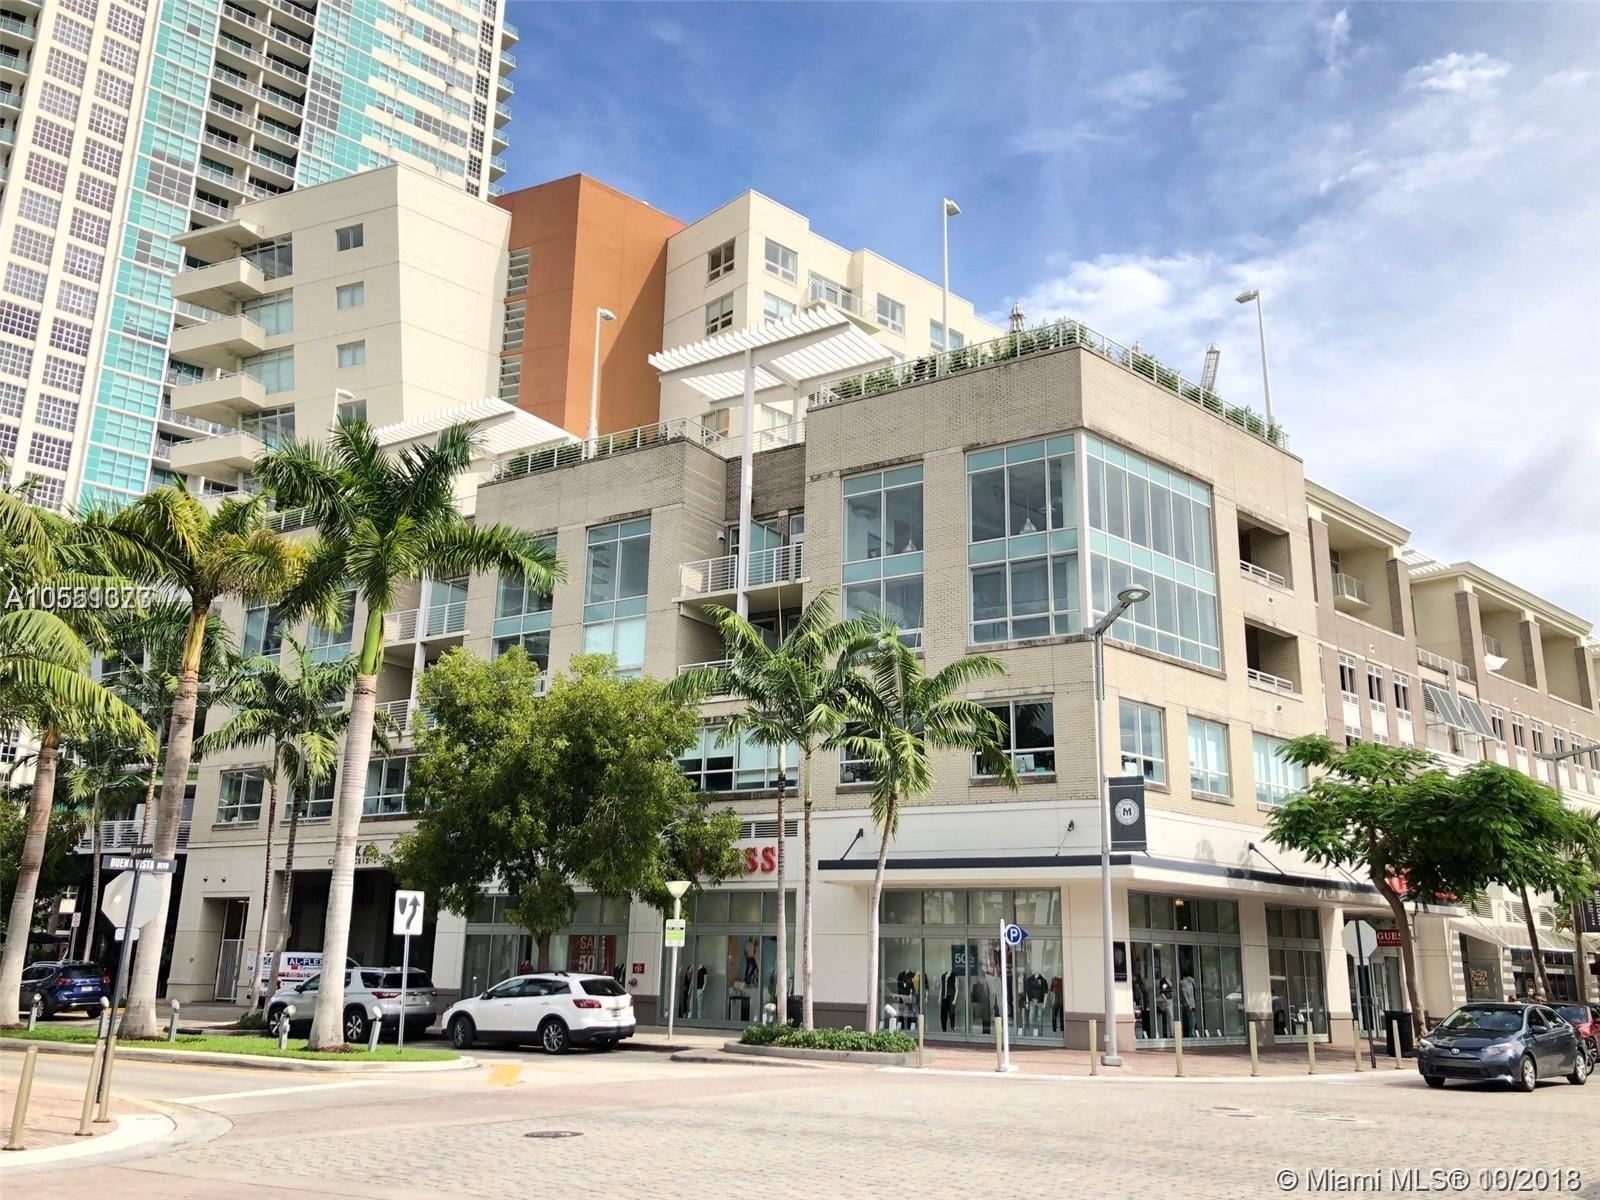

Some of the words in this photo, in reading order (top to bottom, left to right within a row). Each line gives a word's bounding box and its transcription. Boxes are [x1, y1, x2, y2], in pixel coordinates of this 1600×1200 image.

[110, 857, 133, 868] BUENA
[135, 859, 154, 870] VISTA
[1010, 928, 1018, 941] P
[1377, 932, 1402, 941] GUES
